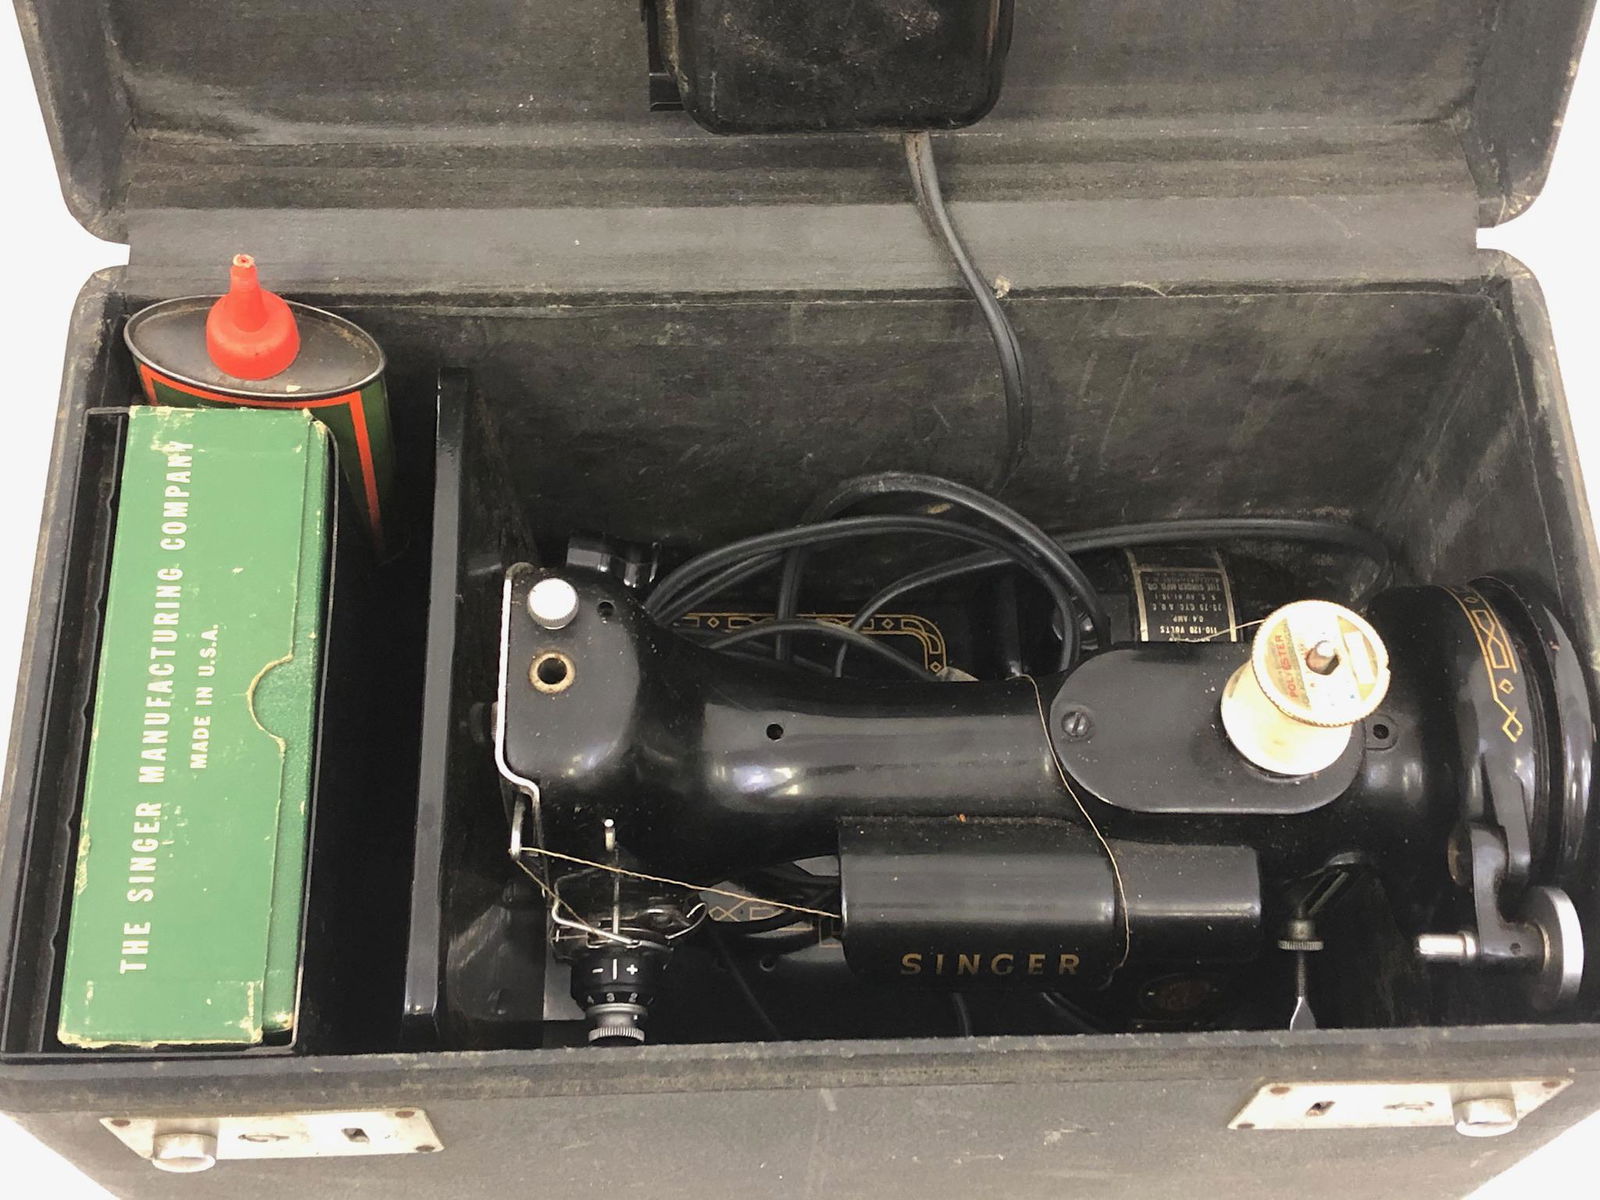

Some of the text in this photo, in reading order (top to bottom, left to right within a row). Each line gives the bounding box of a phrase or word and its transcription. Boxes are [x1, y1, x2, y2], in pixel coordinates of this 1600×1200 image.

[1159, 625, 1186, 635] VOLTS
[119, 440, 194, 975] THE SINGER MANUFACTURING COMPANY
[190, 624, 219, 769] MADE IN U.S.A.
[900, 952, 1081, 976] SINGER
[606, 992, 616, 1002] 3
[628, 992, 638, 1003] 2
